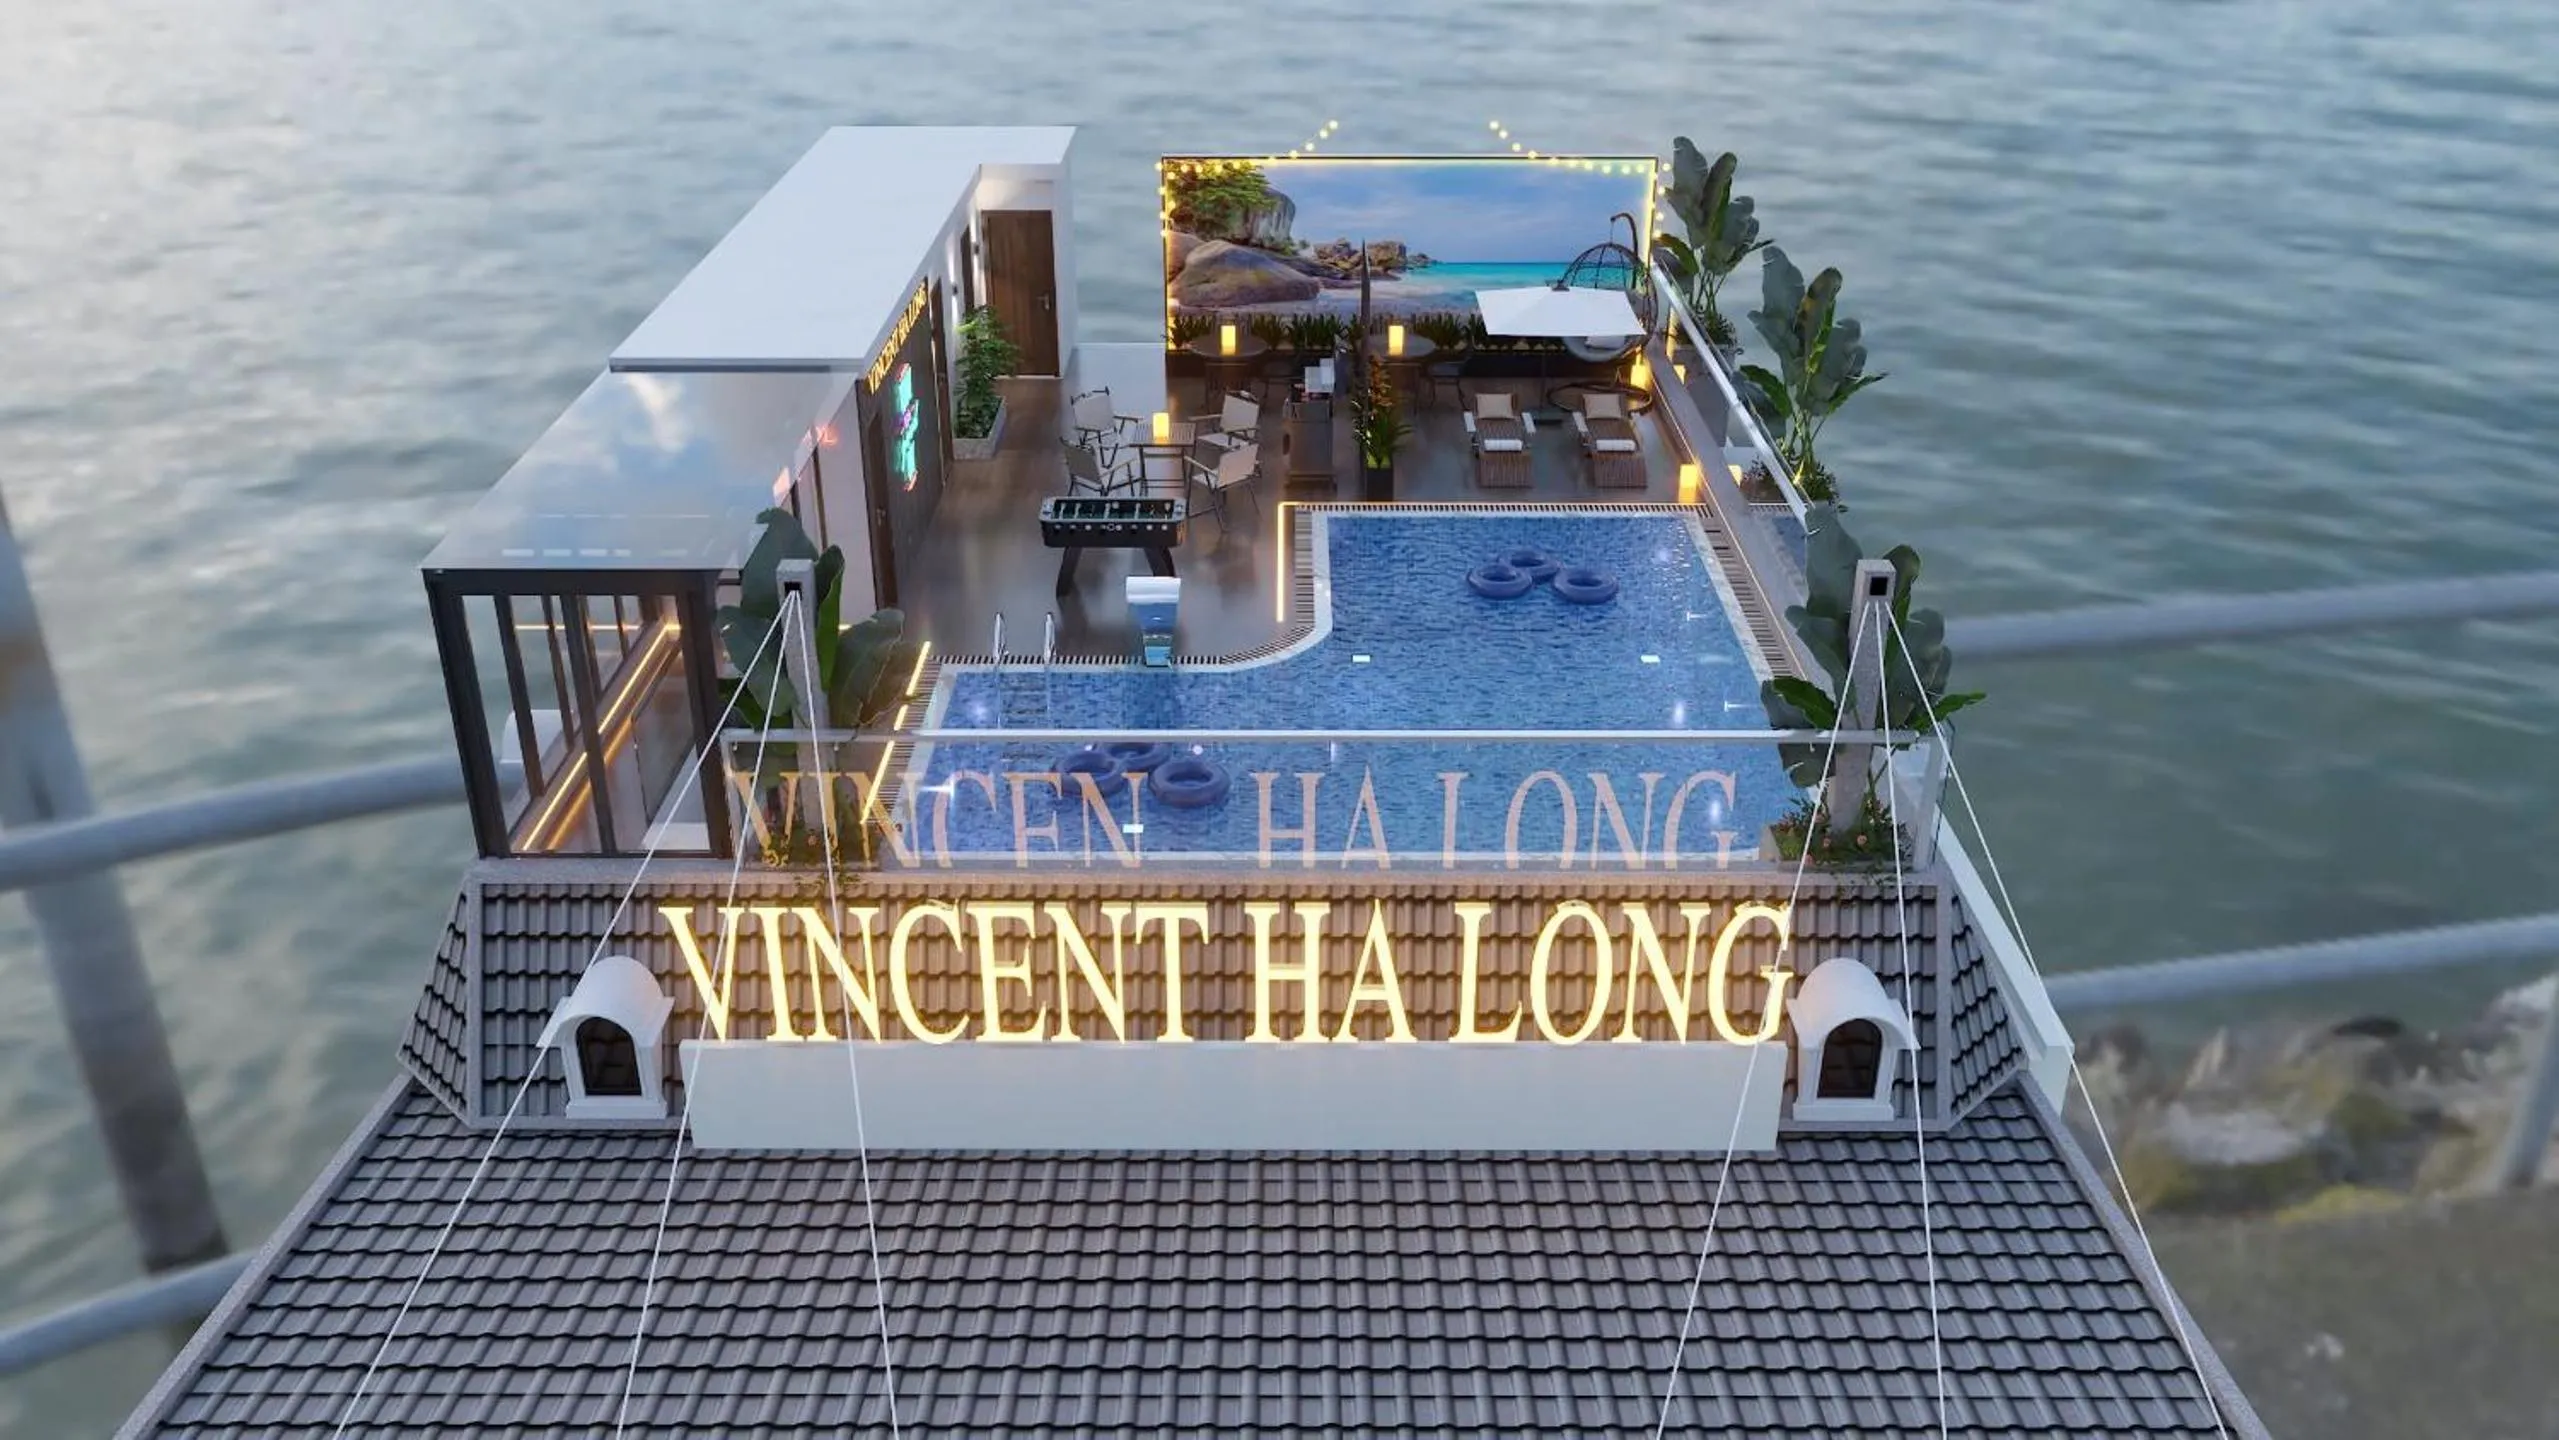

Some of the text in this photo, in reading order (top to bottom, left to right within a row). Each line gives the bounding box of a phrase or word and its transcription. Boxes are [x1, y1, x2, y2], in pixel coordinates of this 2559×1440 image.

[658, 898, 1793, 1045] VINCENT HA LONG
